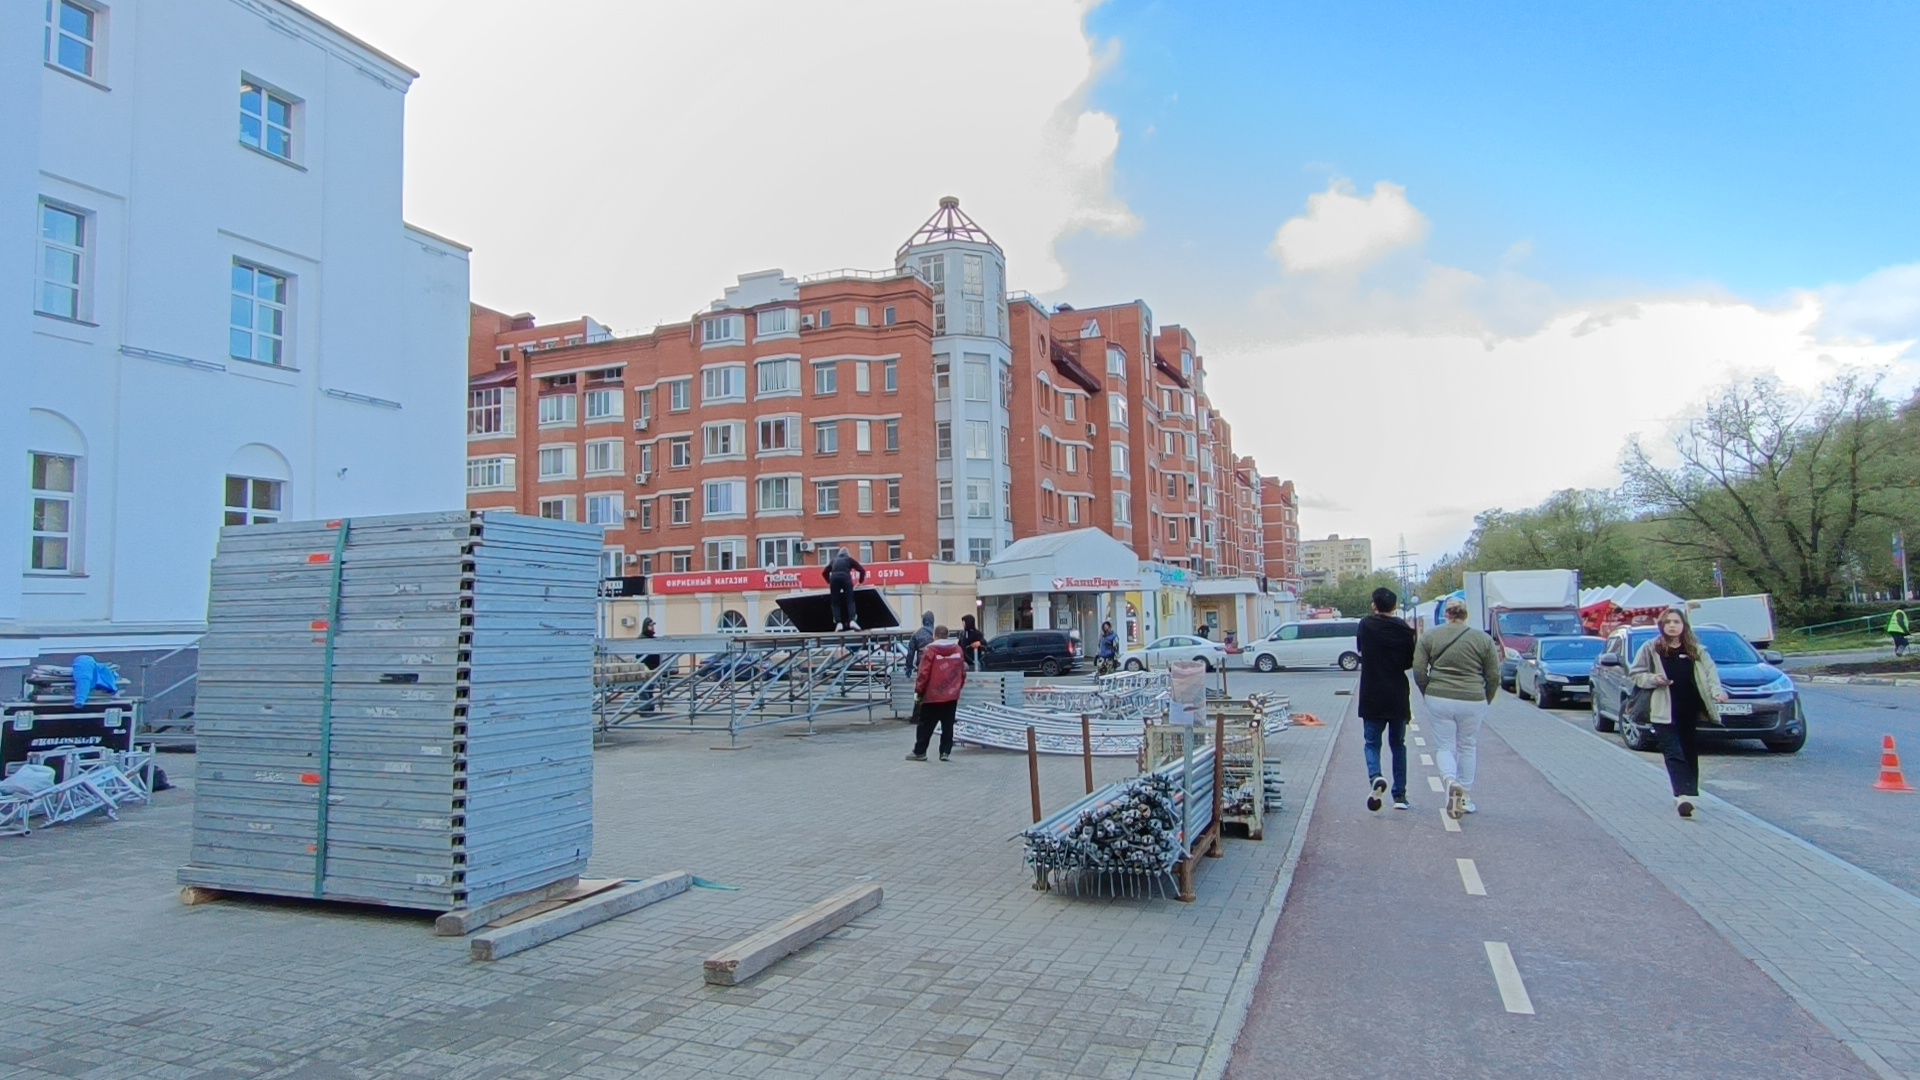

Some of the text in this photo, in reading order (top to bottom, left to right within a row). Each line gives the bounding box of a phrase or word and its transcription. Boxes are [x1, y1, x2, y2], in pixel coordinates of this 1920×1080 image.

[878, 569, 905, 578] ОБУВЬ
[666, 576, 748, 587] ФИРМЕННЫЙ МАГАЗИН
